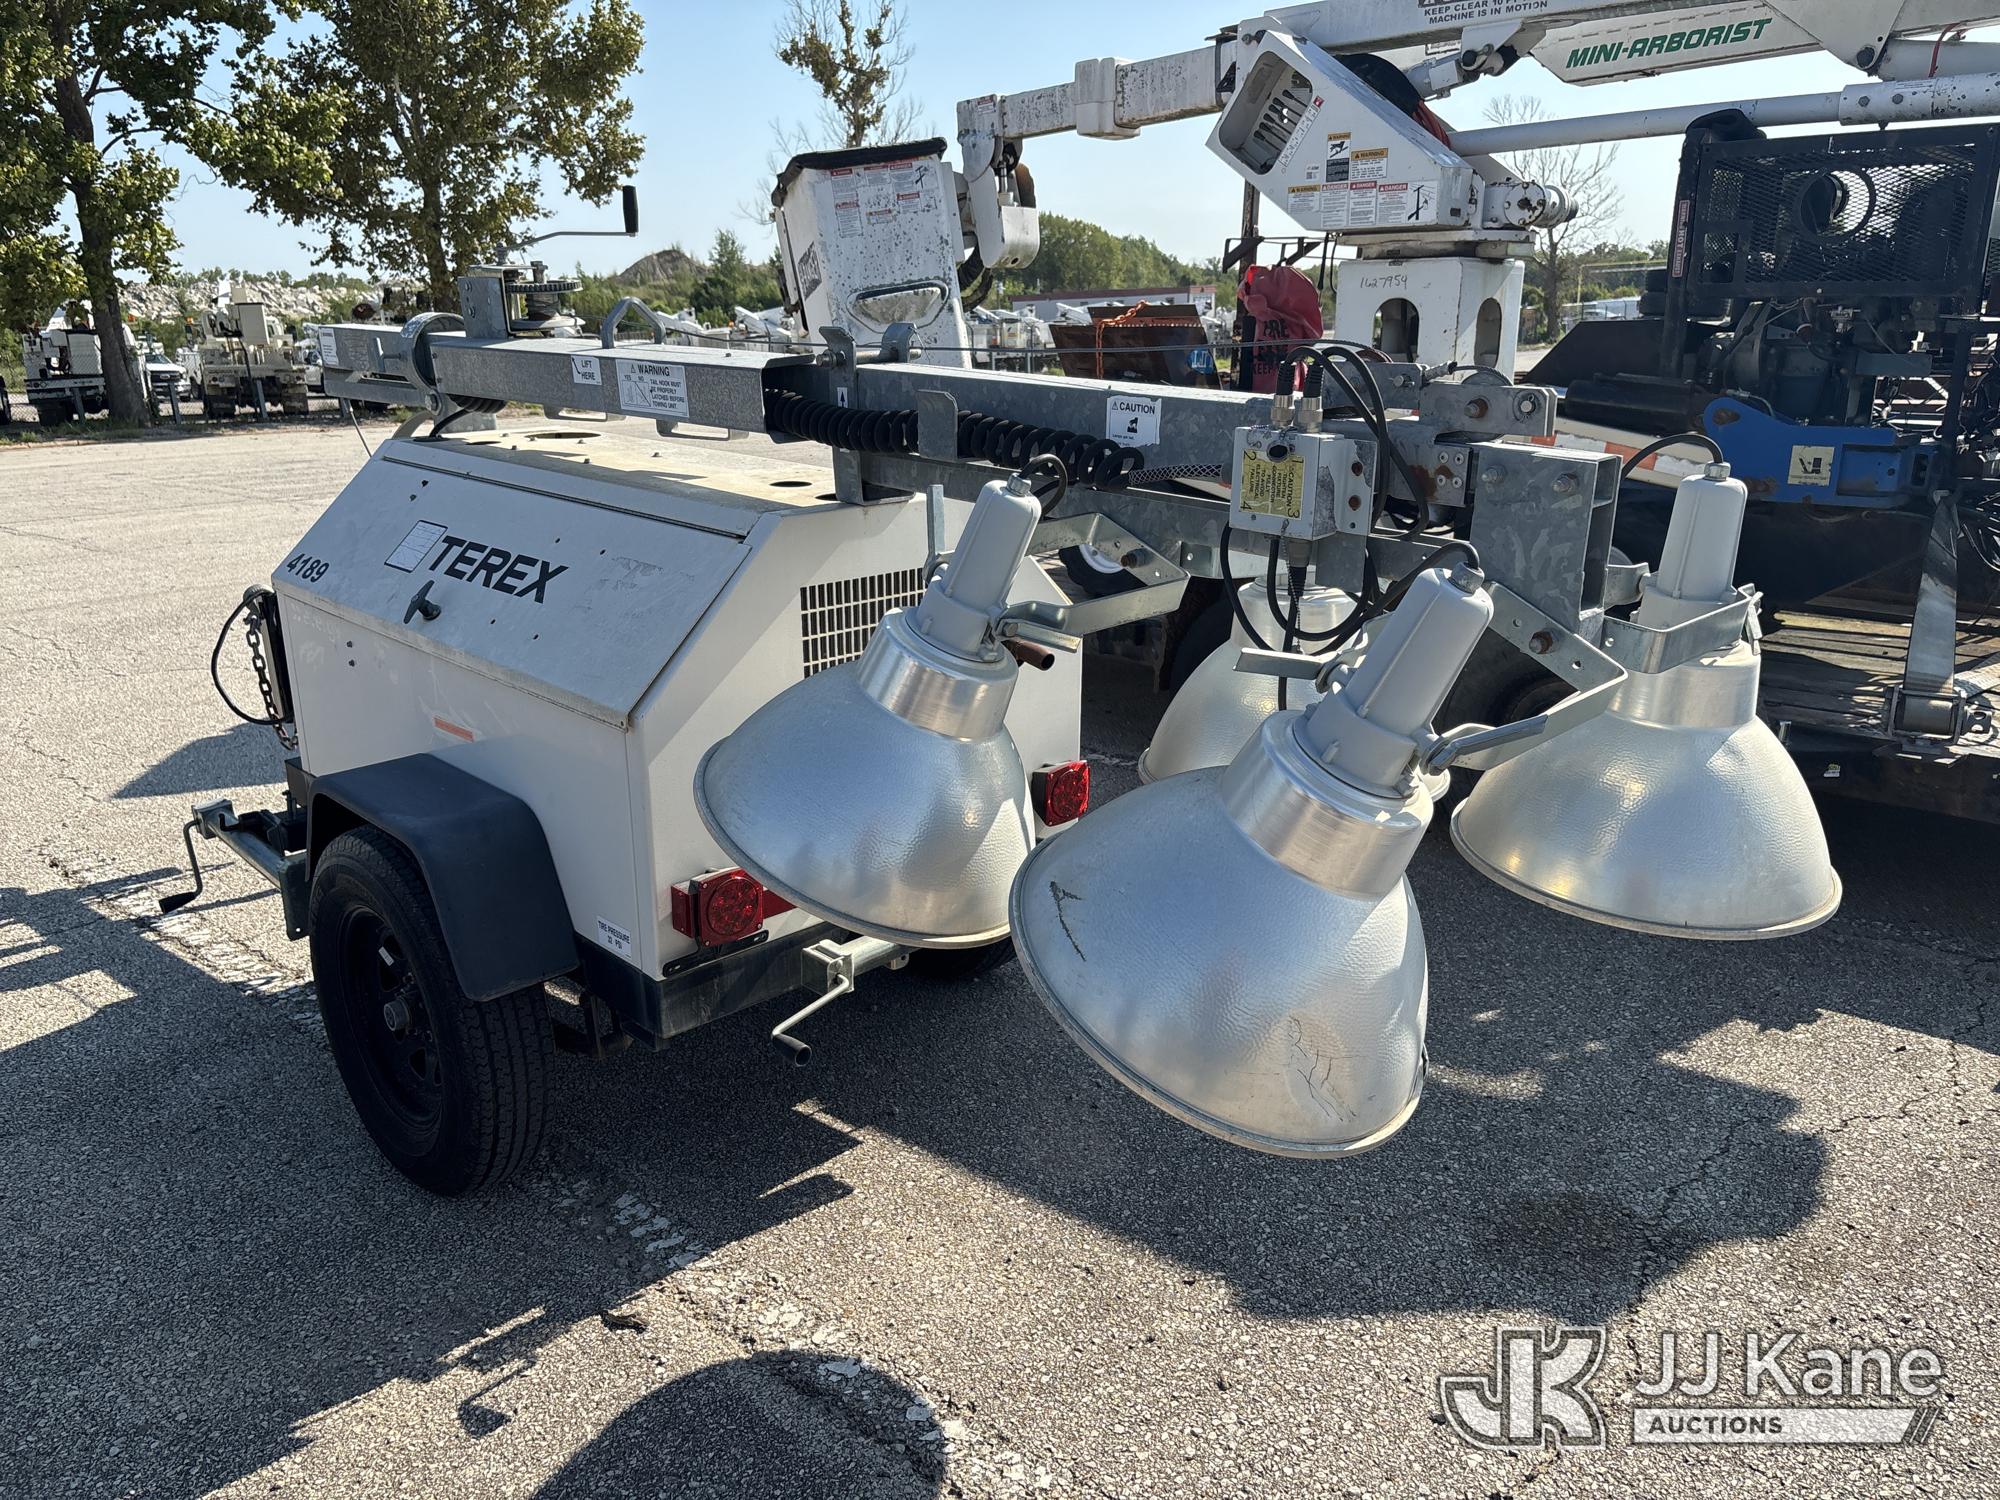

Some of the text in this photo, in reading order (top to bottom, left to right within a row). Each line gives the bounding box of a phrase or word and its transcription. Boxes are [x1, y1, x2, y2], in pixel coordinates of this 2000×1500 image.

[1424, 8, 1451, 16] KEEP
[1454, 1, 1488, 12] CLEAR
[1429, 1, 1548, 24] MACHINE IS IN MOTION
[1566, 18, 1772, 68] MINI-ARBORIST
[1360, 150, 1385, 158] WARNING
[1360, 274, 1408, 290] 1627954
[581, 360, 592, 369] LIFT
[637, 364, 670, 377] WARNING
[581, 372, 596, 381] HERE
[657, 386, 677, 394] PROPERLY
[1119, 401, 1156, 415] CAUTION
[1244, 450, 1257, 461] 2
[1286, 471, 1295, 507] CAUTION
[1240, 501, 1252, 510] 4
[1288, 508, 1300, 519] 3
[286, 553, 330, 583] 4189
[428, 535, 569, 604] TEREX
[598, 920, 630, 944] TIRE PRESSURE
